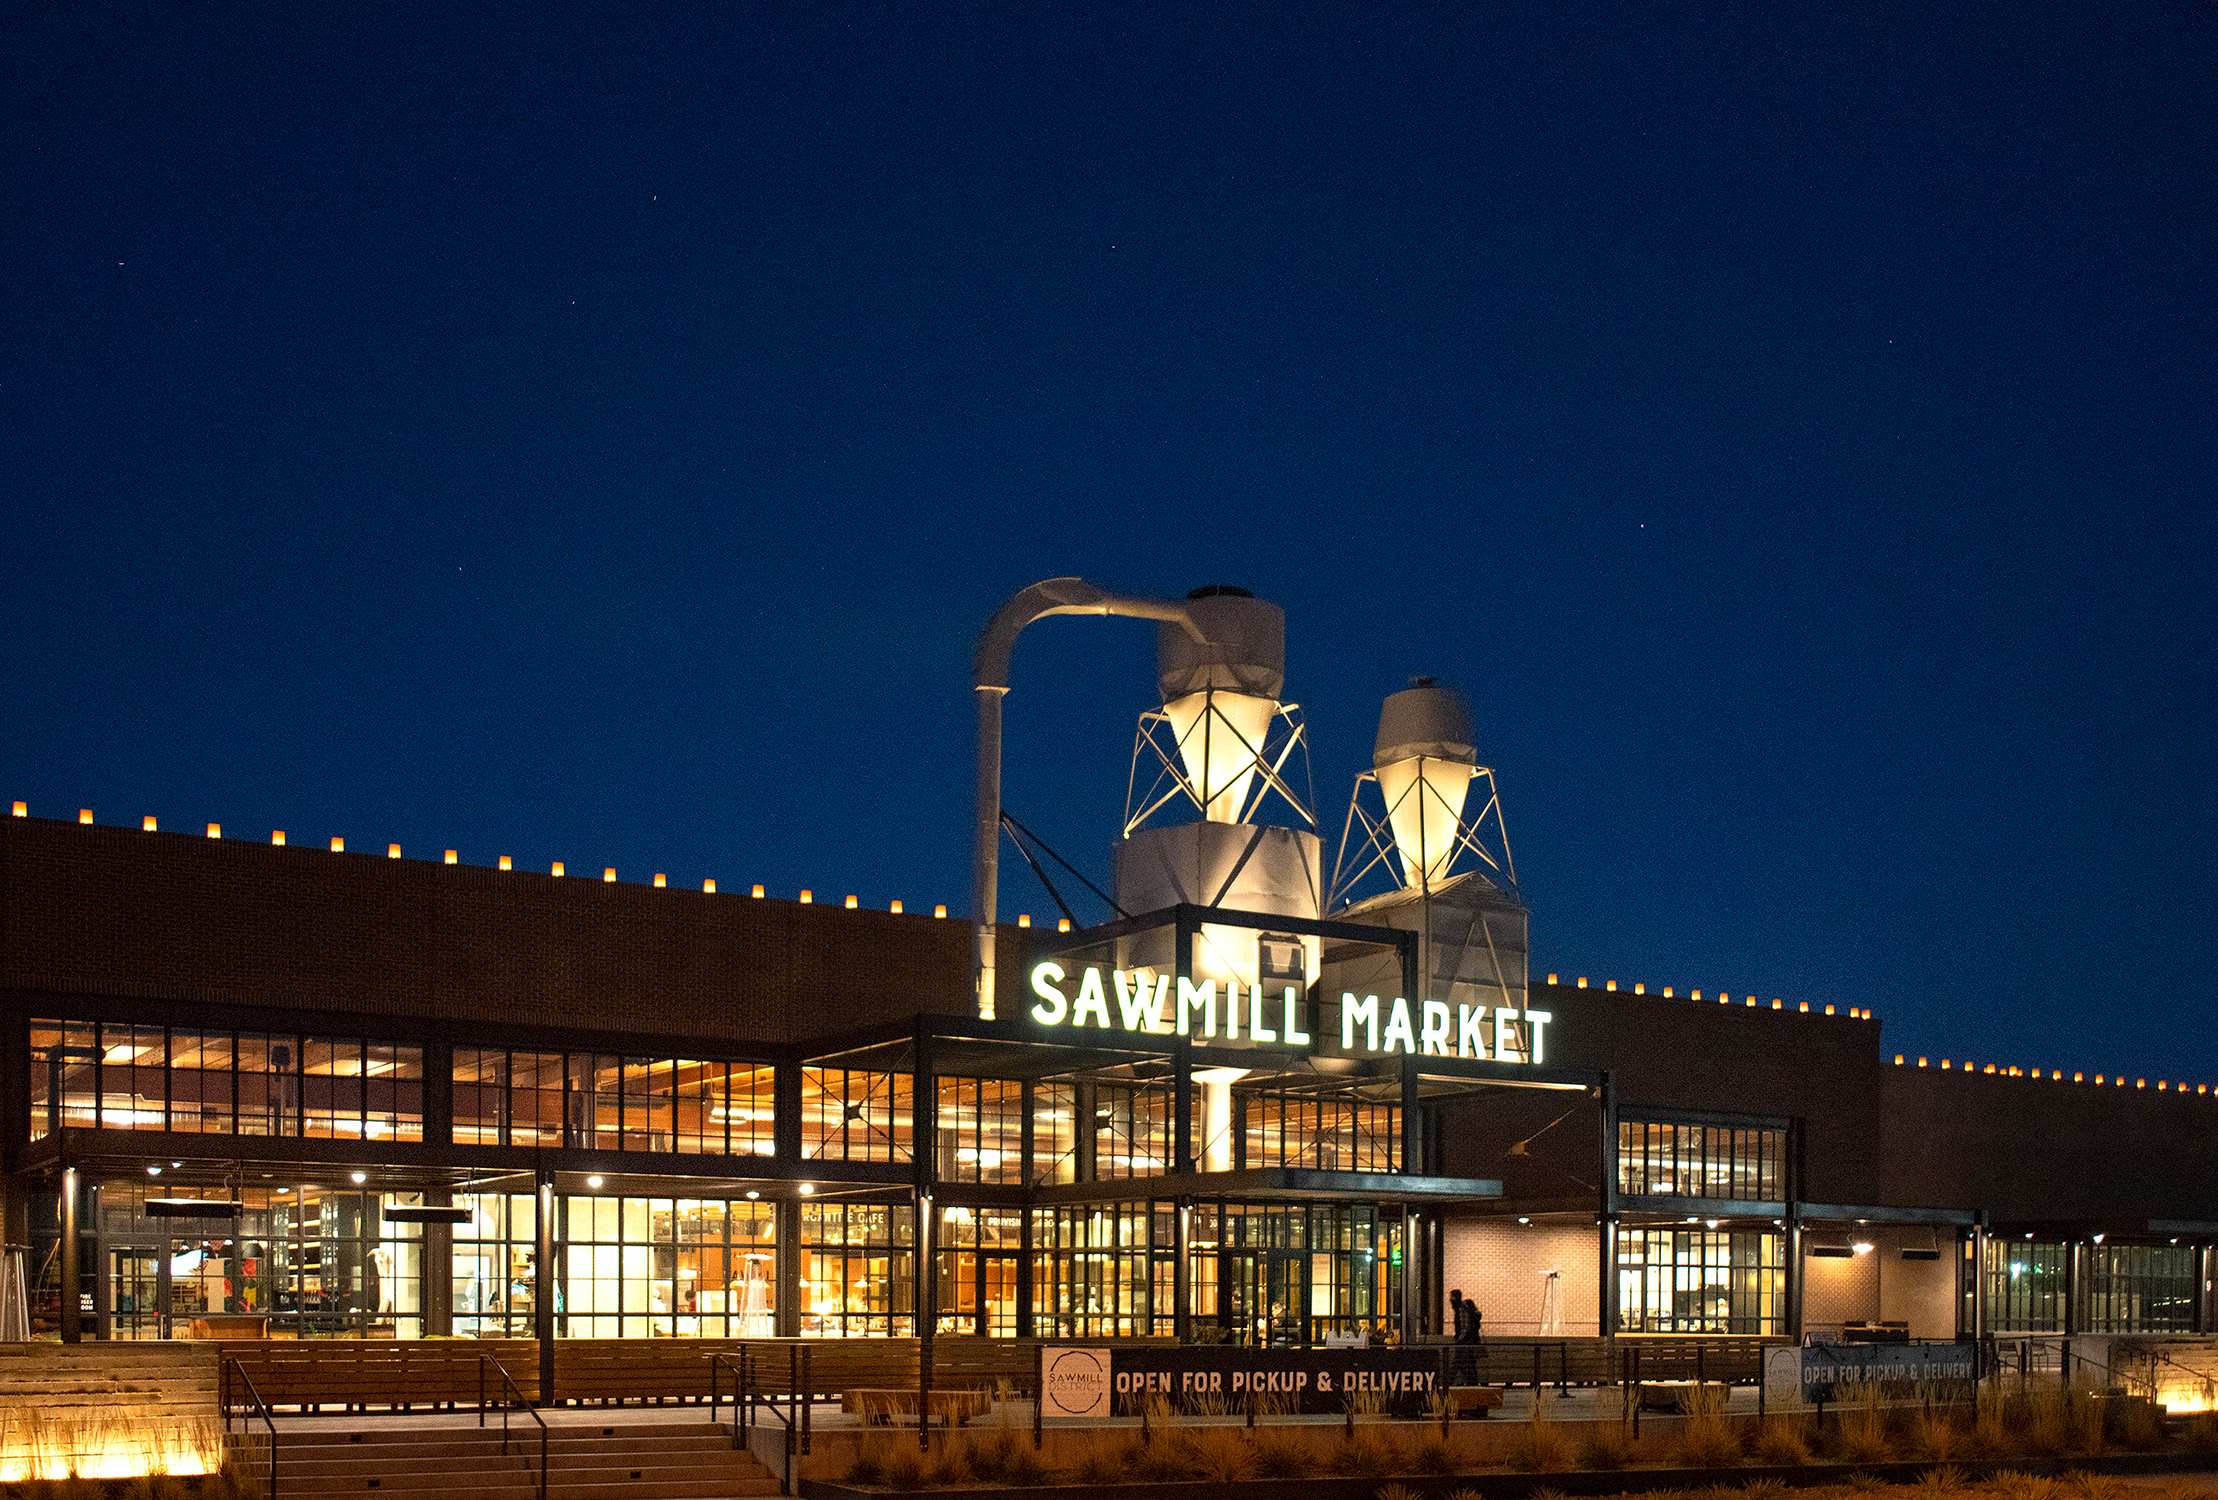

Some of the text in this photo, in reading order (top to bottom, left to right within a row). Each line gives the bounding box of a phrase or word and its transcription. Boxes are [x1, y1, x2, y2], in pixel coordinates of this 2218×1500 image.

[1030, 962, 1552, 1064] SAWMILL MARKET
[1049, 1373, 1102, 1383] SAWMILL
[1116, 1371, 1436, 1393] OPEN FOR PICKUP & DELIVERY
[1804, 1367, 1834, 1384] OPEN
[1840, 1366, 1860, 1383] FOR
[1865, 1364, 1904, 1381] PICKUP
[1910, 1363, 1918, 1380] &
[1924, 1362, 1972, 1380] DELIVERY
[1049, 1382, 1101, 1391] DISTRICT
